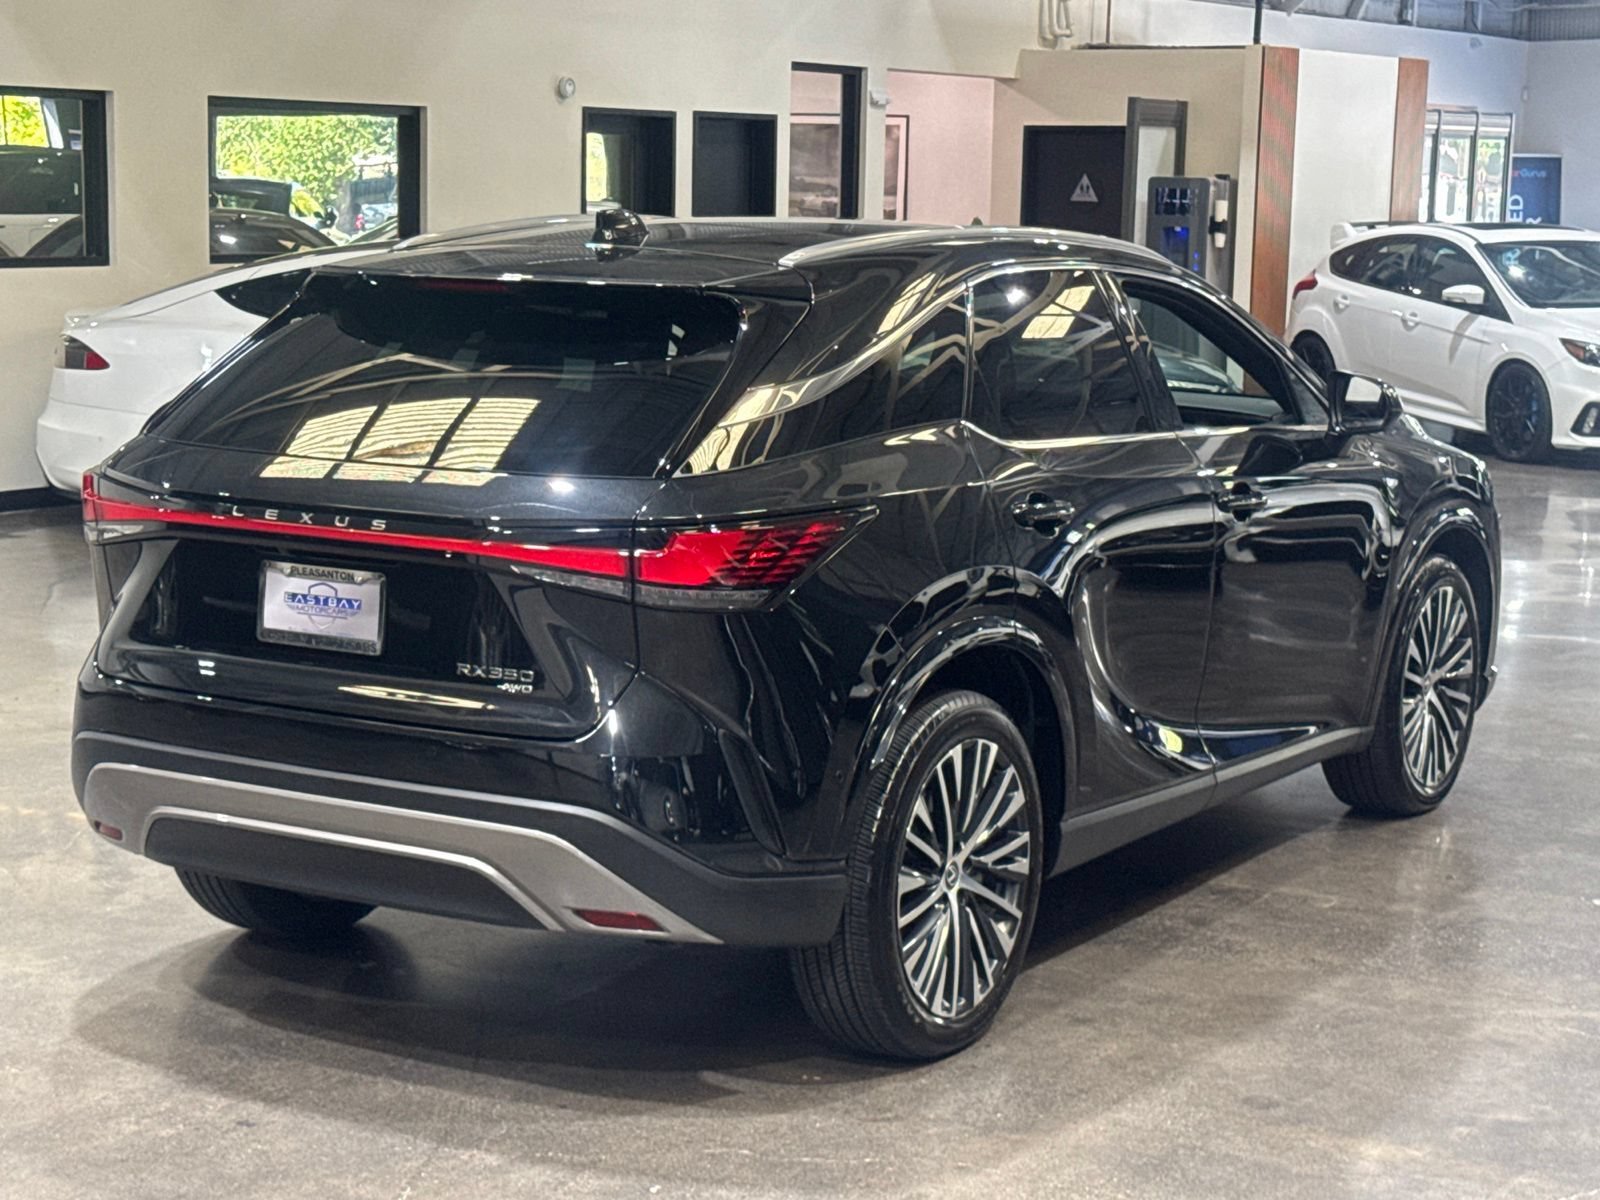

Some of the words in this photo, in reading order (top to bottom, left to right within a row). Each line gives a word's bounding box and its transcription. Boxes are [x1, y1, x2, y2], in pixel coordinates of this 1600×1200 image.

[232, 505, 387, 531] LEXUS
[289, 565, 355, 581] PLEASANTON
[456, 662, 535, 683] RX350
